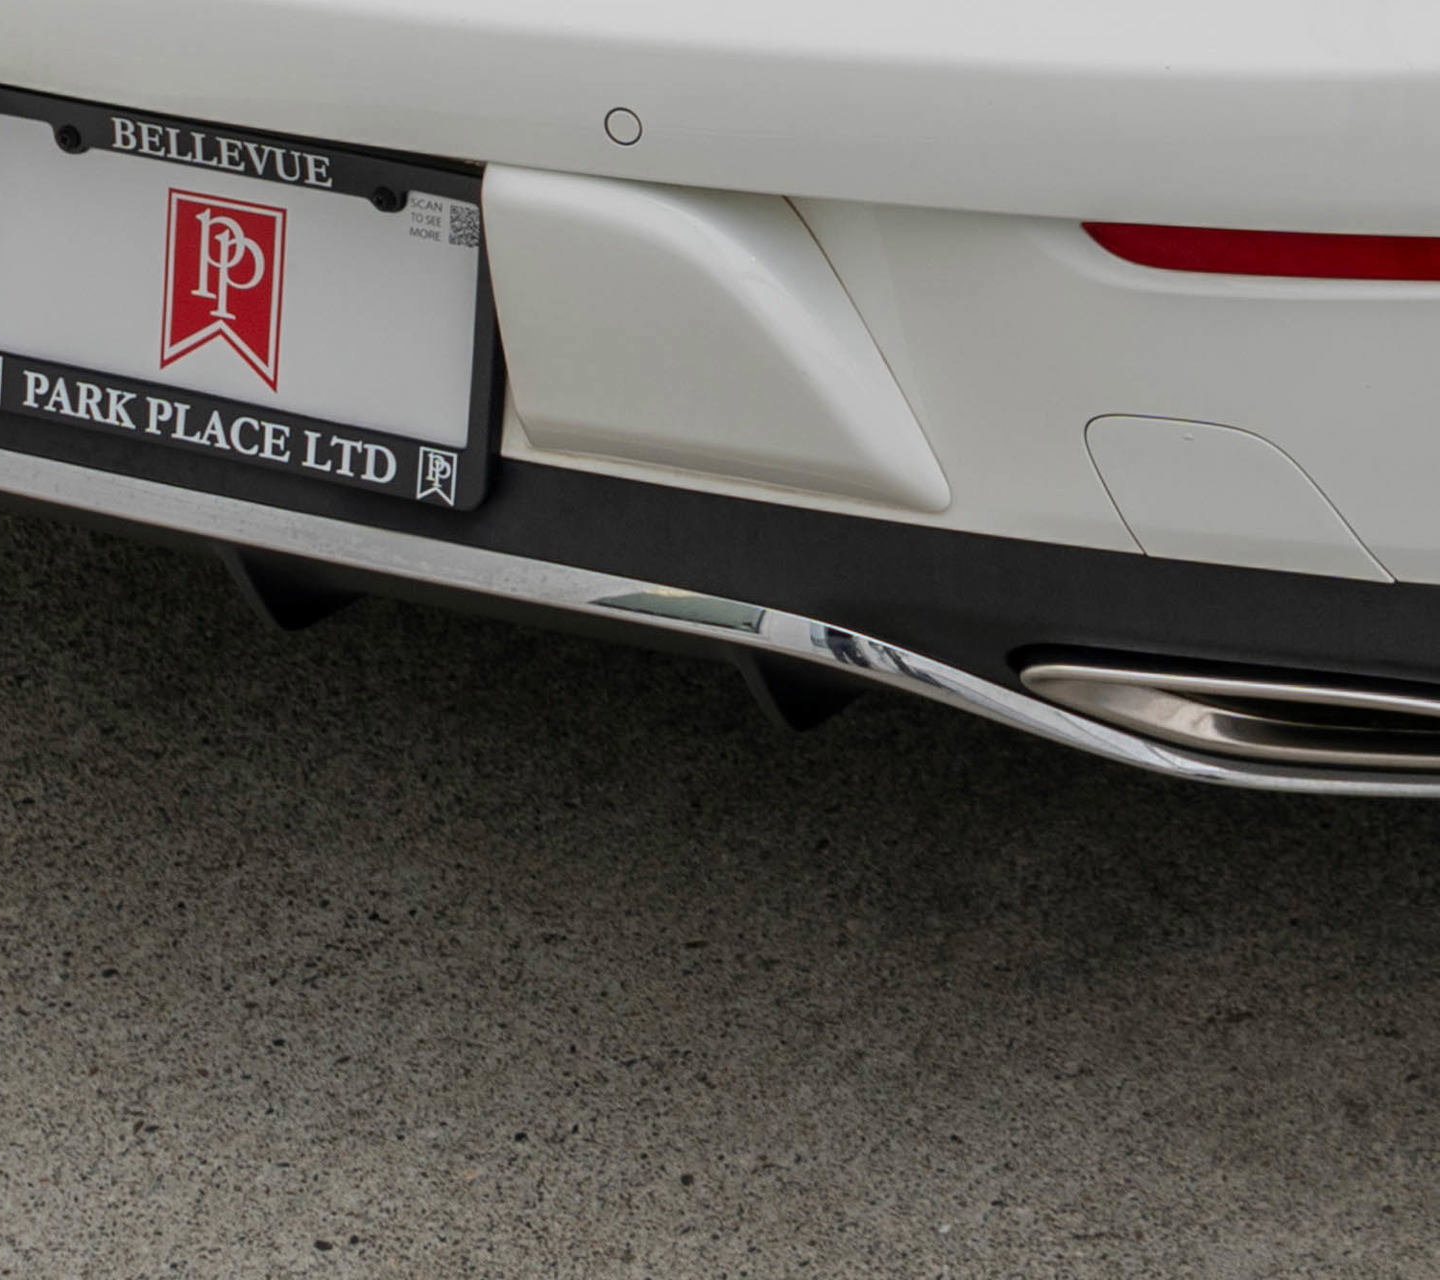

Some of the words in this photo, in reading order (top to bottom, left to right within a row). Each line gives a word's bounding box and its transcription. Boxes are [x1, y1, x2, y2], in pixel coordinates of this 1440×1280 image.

[111, 116, 333, 188] BELLEVUE
[409, 197, 443, 213] SCAN
[410, 211, 424, 224] TO
[425, 214, 442, 228] SEE
[408, 226, 441, 242] MORE
[22, 369, 137, 432] PARK
[145, 396, 292, 464] PLACE
[302, 430, 398, 486] LTD
